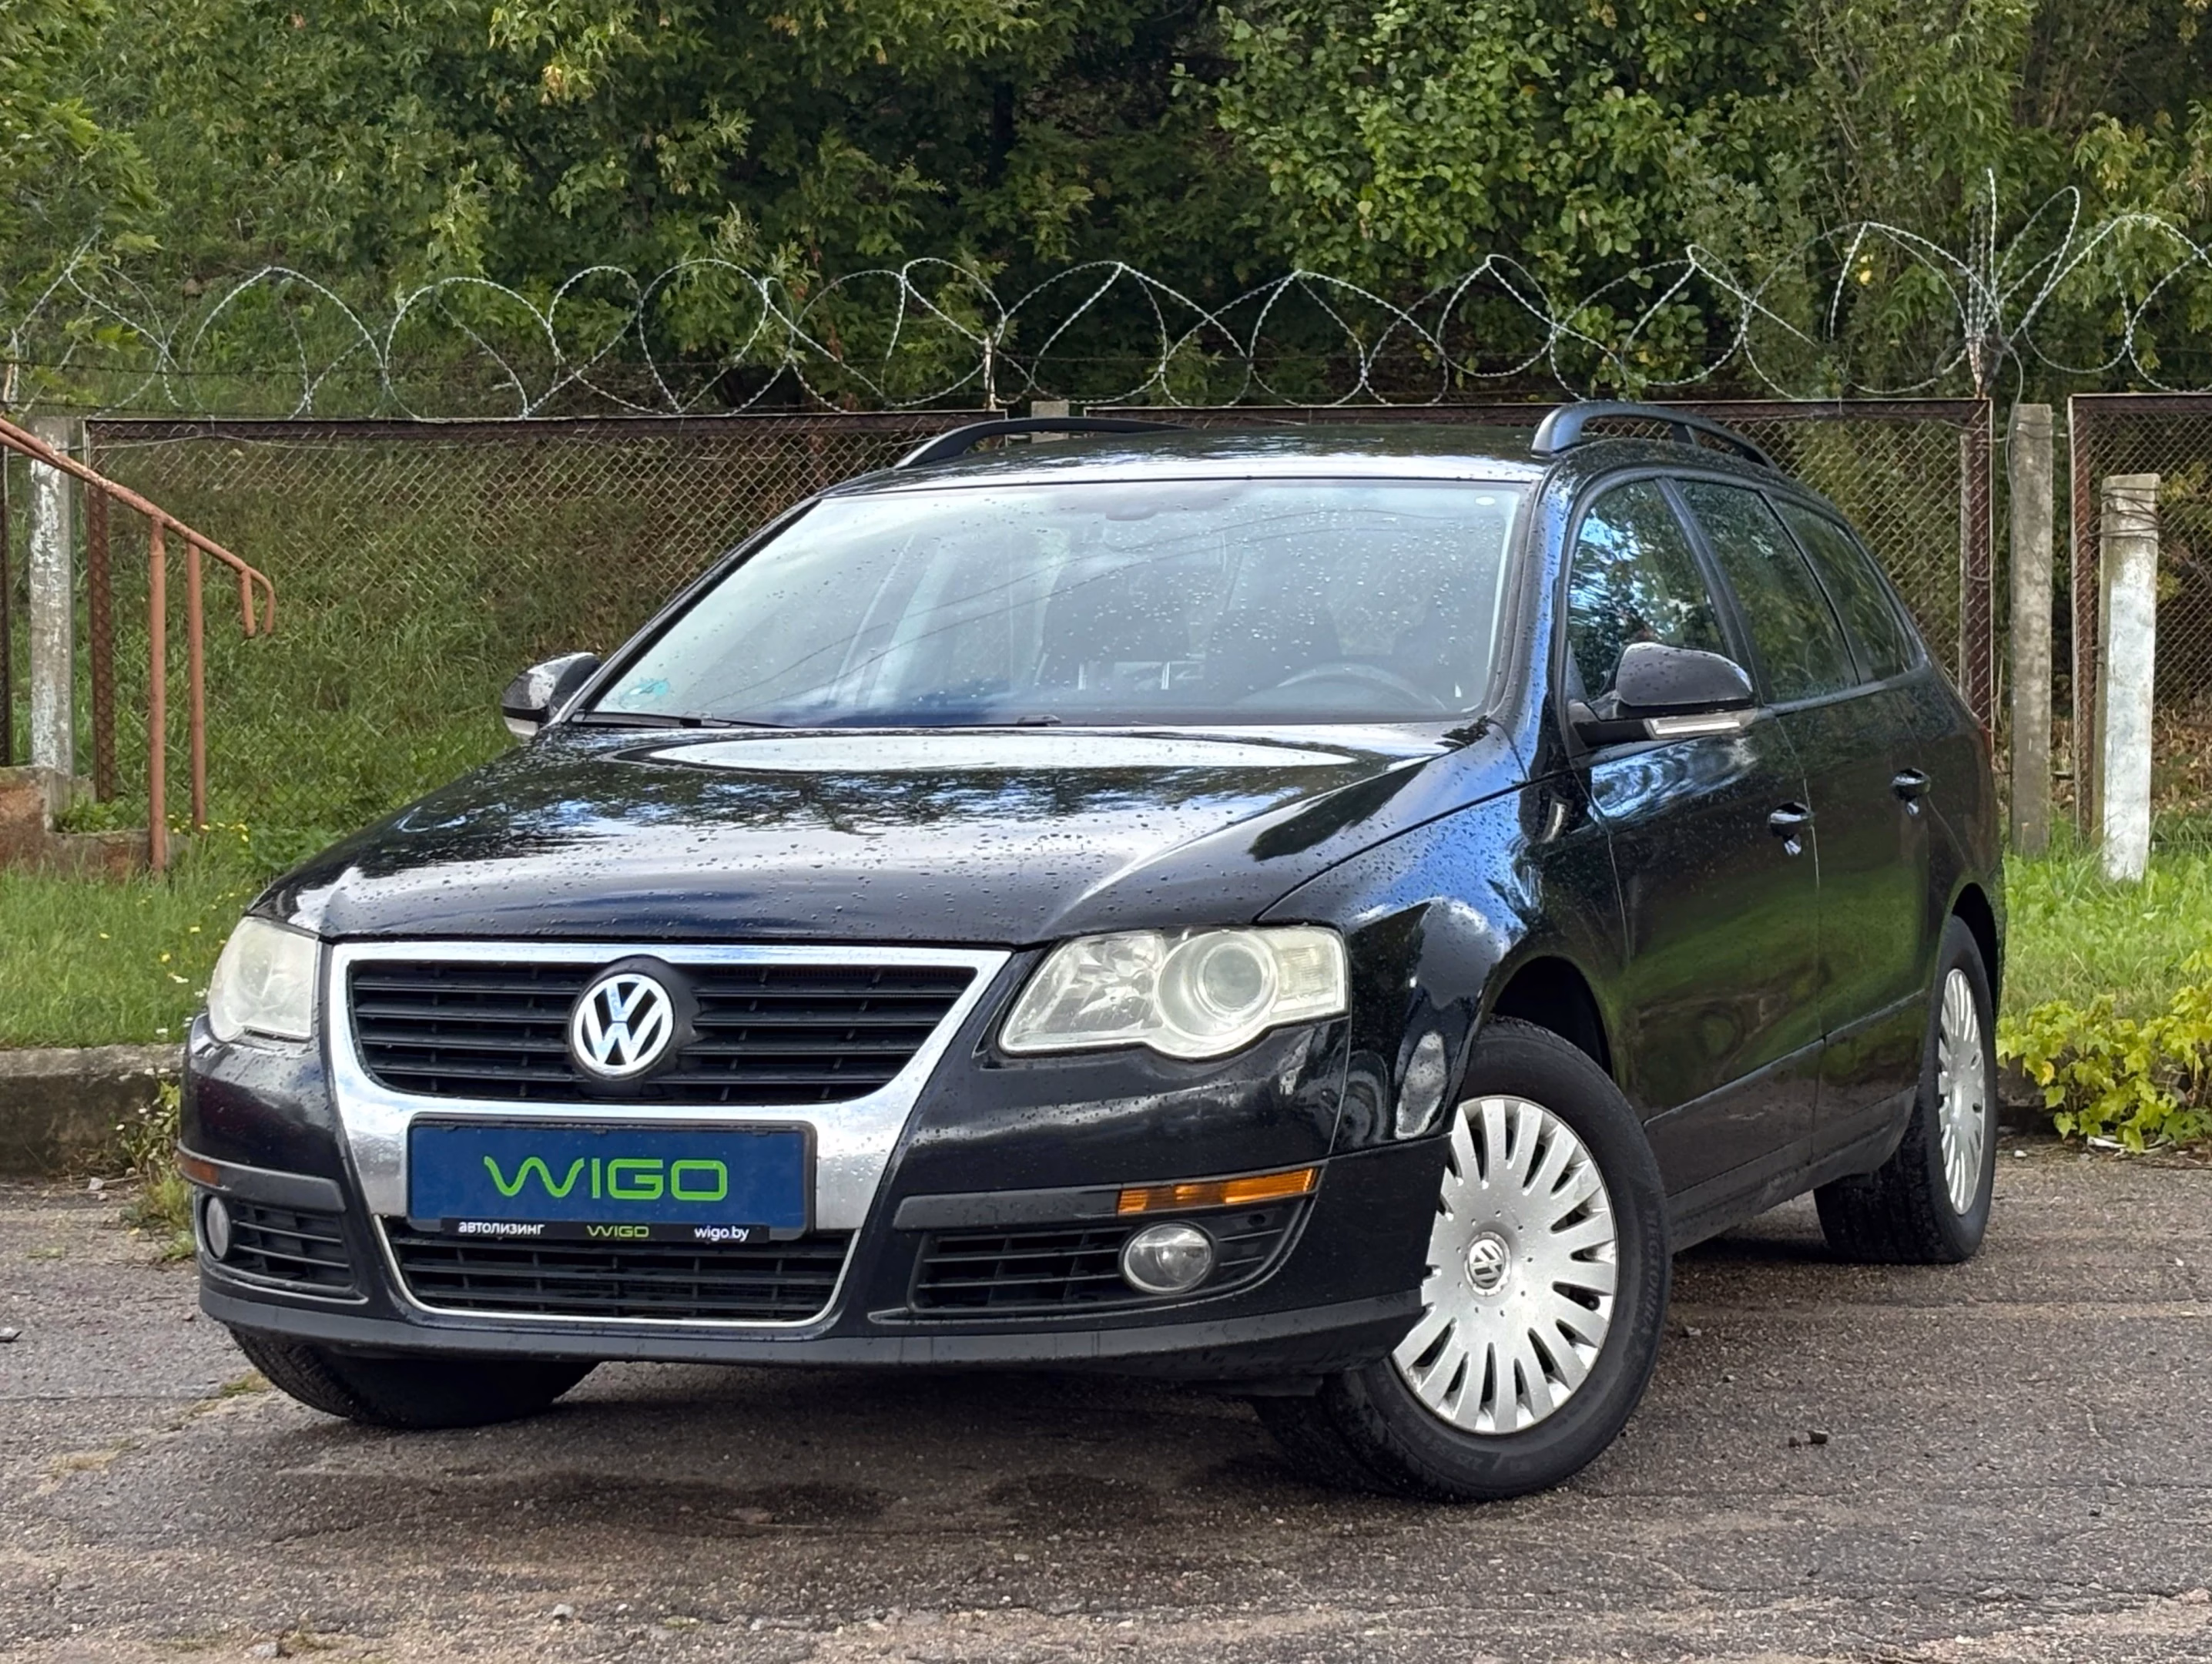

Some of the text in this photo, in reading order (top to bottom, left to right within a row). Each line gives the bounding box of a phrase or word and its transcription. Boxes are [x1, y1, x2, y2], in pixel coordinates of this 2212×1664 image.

[484, 1156, 728, 1202] WIGO
[457, 1221, 546, 1236] автолизинг
[586, 1225, 749, 1241] WIGO wigo.by
